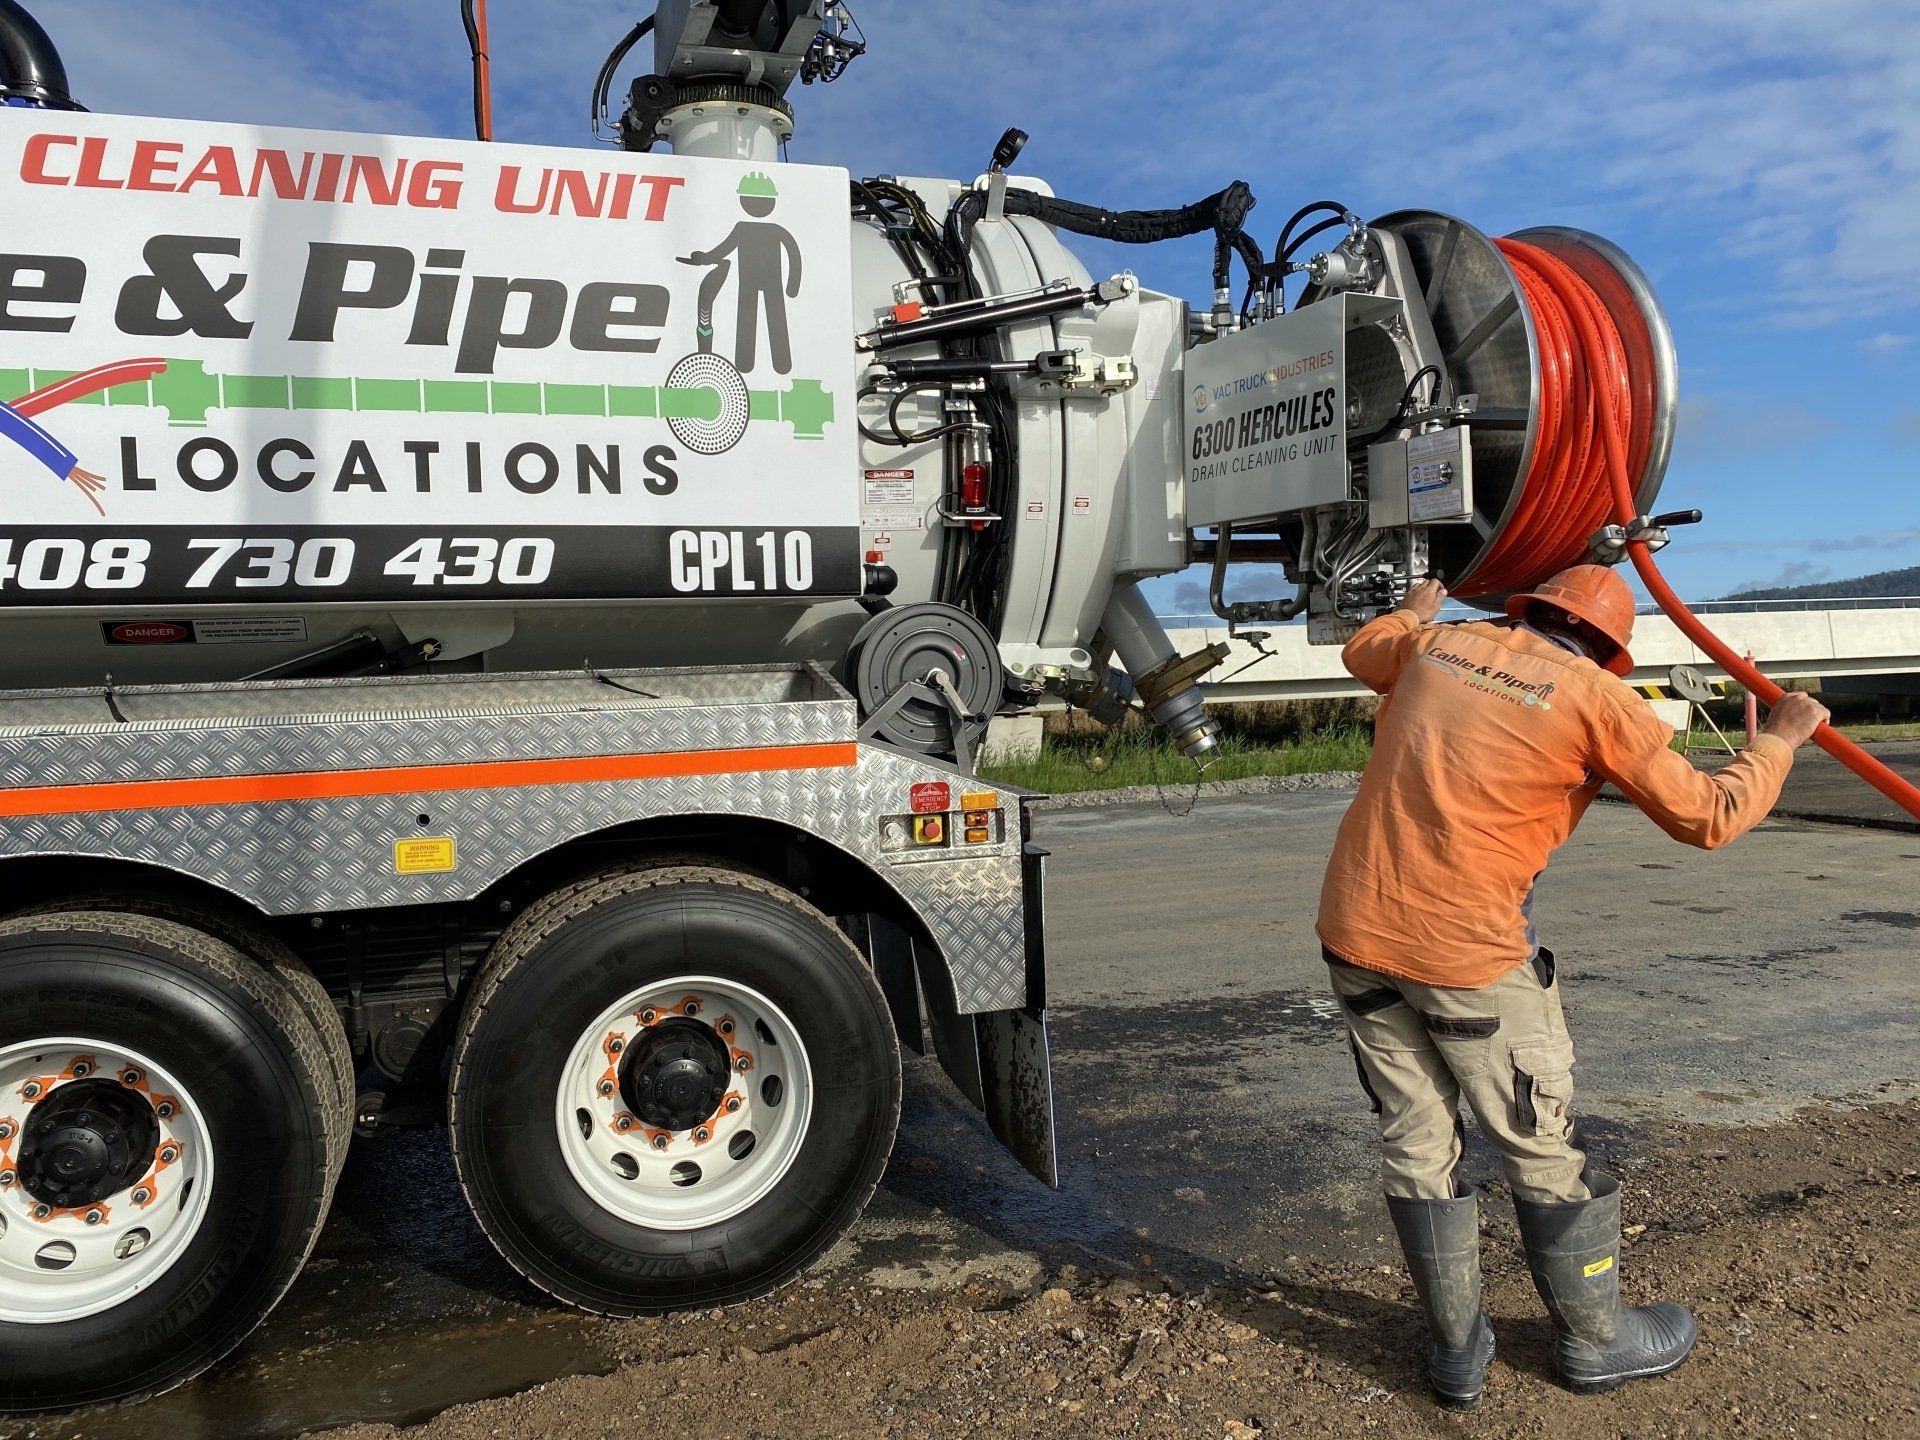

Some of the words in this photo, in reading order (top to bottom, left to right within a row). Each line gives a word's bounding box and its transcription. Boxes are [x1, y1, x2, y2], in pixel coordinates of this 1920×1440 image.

[21, 134, 463, 209] CLEANING
[494, 165, 685, 221] UNIT
[114, 234, 255, 340] &
[287, 241, 671, 375] Pipe
[1213, 384, 1231, 400] VAC
[1233, 371, 1267, 393] TRUCK
[1269, 350, 1335, 384] INDUSTRIES
[1193, 417, 1236, 460] 6300
[1238, 387, 1336, 449] HERCULES
[120, 436, 679, 496] LOCATIONS
[1191, 461, 1228, 482] DRAIN
[1232, 443, 1298, 473] CLEANING
[1303, 434, 1338, 457] UNIT
[0, 538, 152, 590] 08
[184, 537, 356, 588] 730
[383, 537, 555, 586] 430
[669, 529, 812, 592] CPL10
[125, 628, 175, 637] DANGER
[1427, 647, 1476, 671] Cable
[1475, 665, 1492, 677] &
[1491, 671, 1536, 692] Pipe
[1463, 680, 1521, 706] LOCATIONS
[915, 795, 948, 803] EMERGENCY
